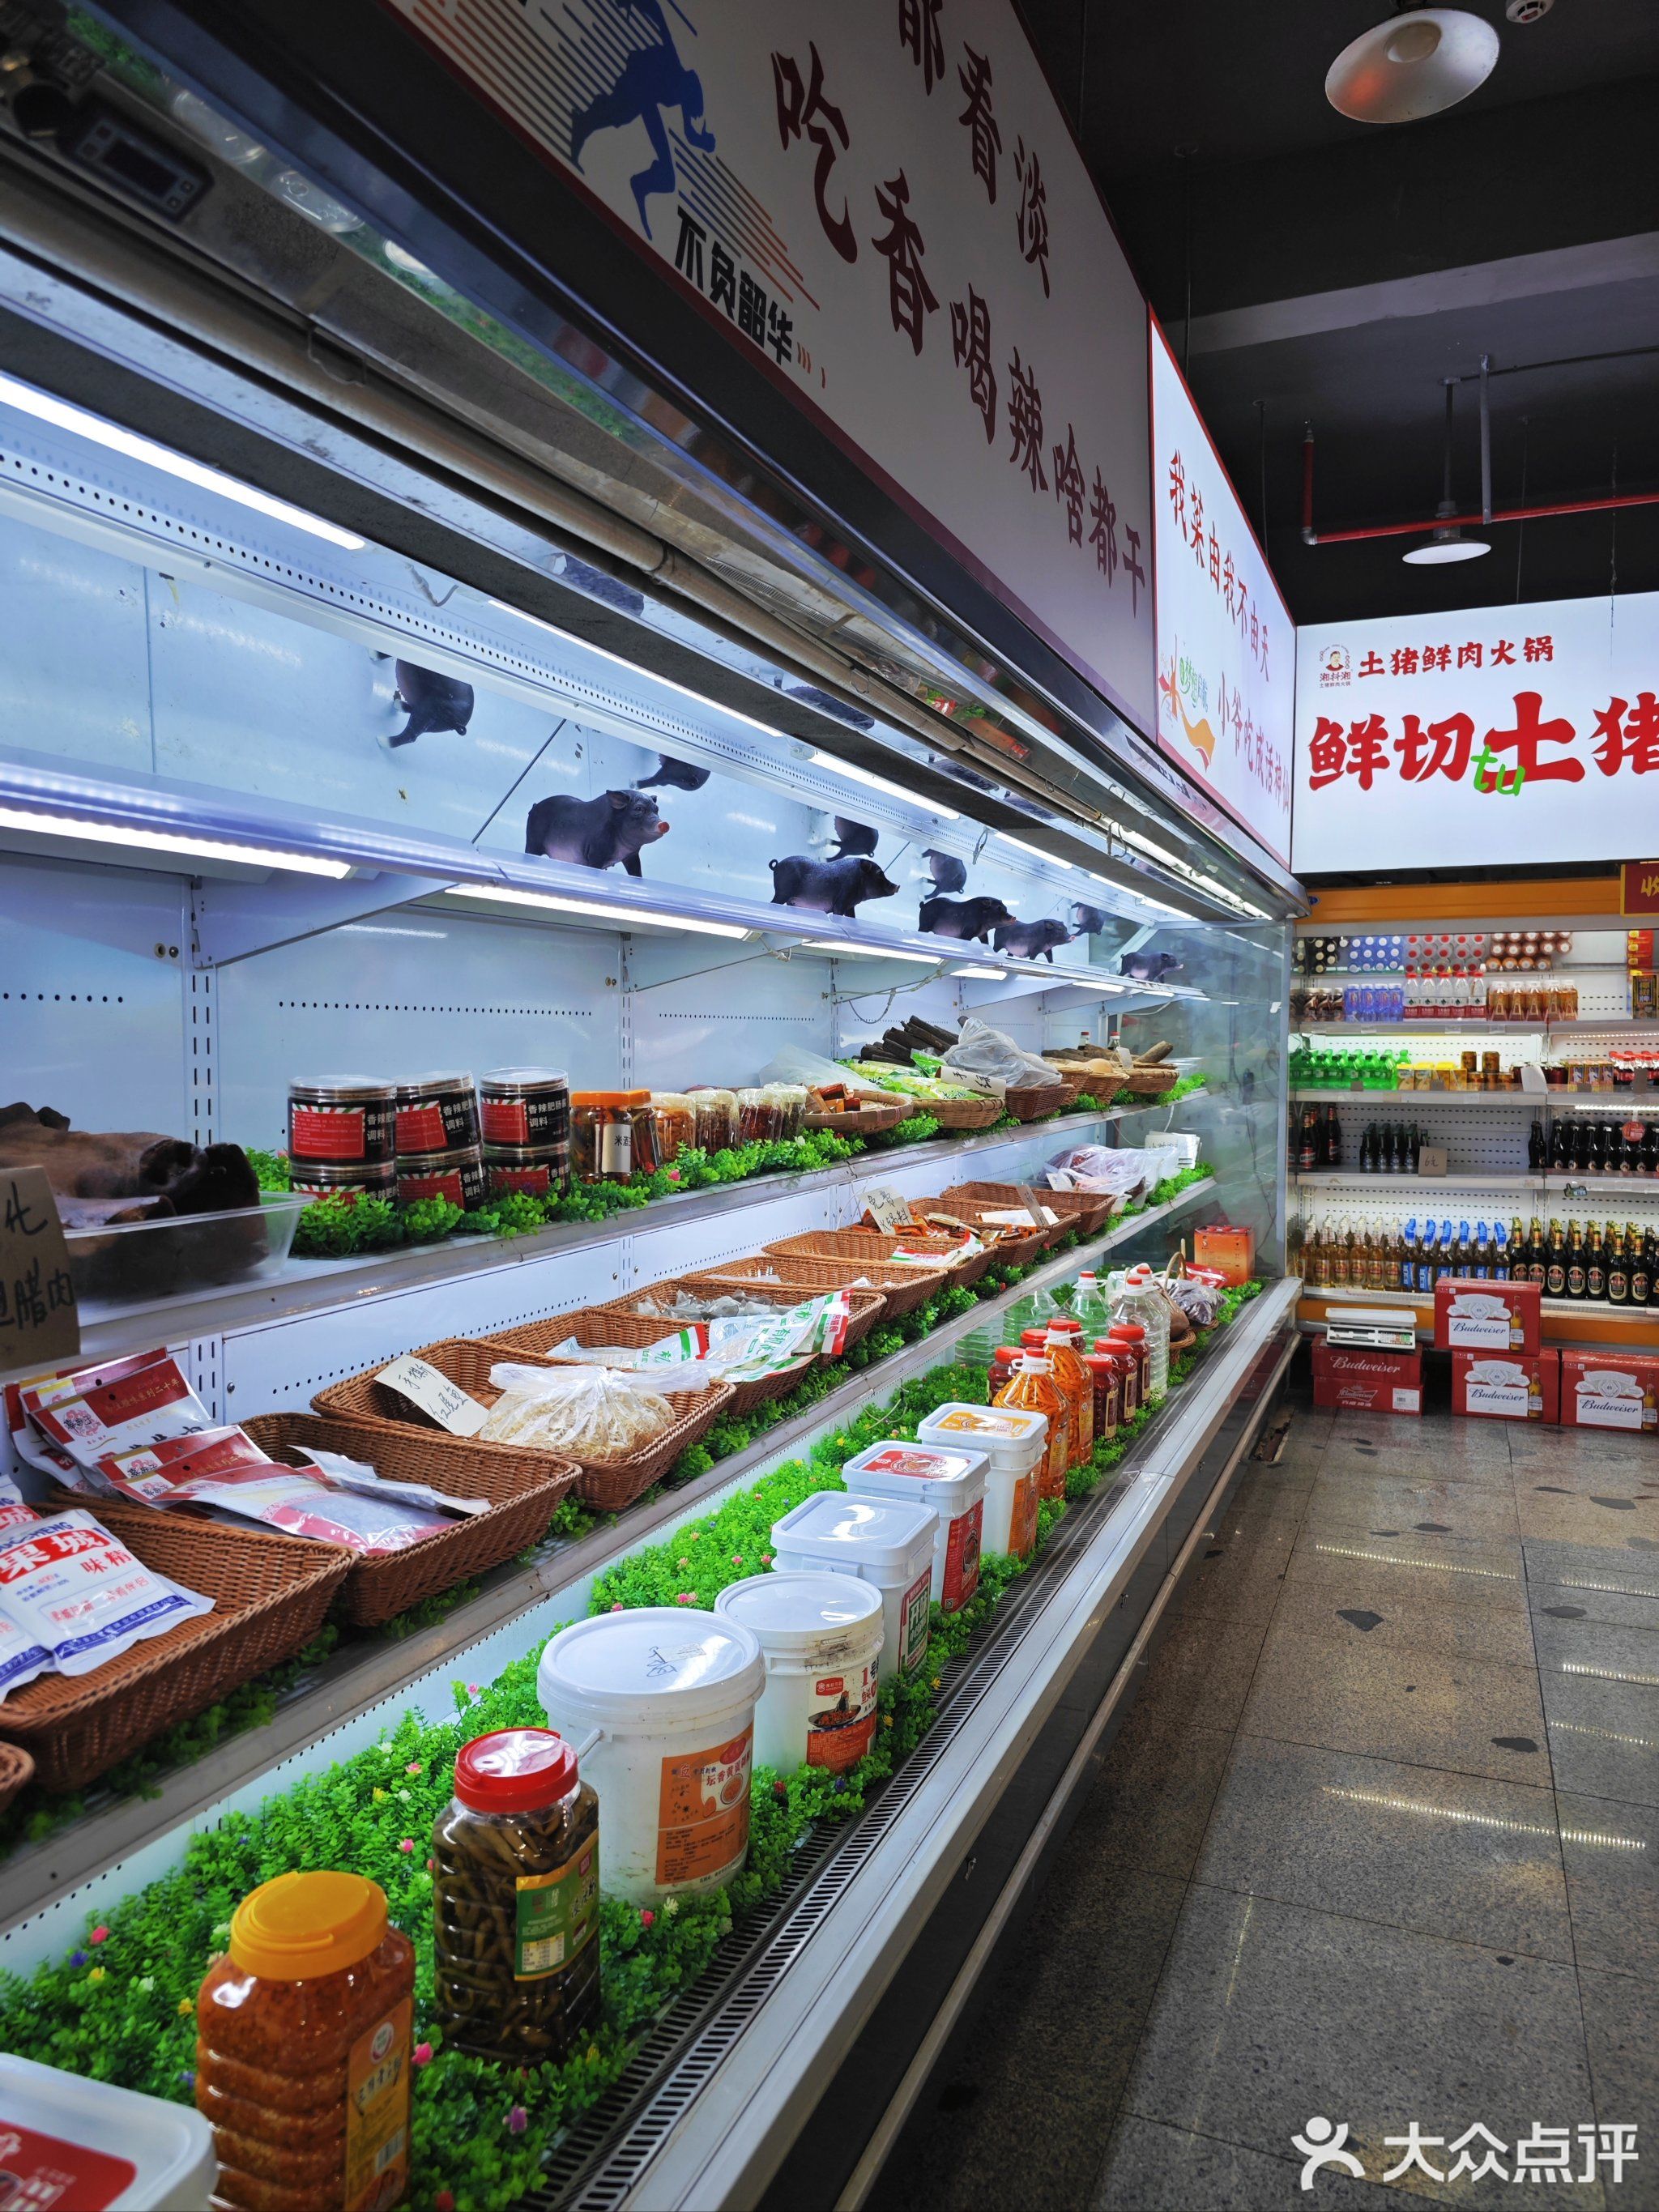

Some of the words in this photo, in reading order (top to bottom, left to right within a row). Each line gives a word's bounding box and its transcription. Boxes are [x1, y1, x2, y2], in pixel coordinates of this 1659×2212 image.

[674, 205, 794, 365] 不负韶华
[770, 40, 1145, 618] 吃香喝辣啥都干
[1169, 448, 1269, 682] 我菜由我不由天
[1358, 635, 1555, 679] 土猪鲜肉火锅
[1470, 744, 1526, 797] tu
[1451, 1321, 1507, 1335] Budweiser
[1330, 1355, 1401, 1373] Budweiser
[1468, 1387, 1525, 1402] Budweiser
[1580, 1398, 1639, 1414] Budweiser
[81, 1549, 132, 1575] 味精
